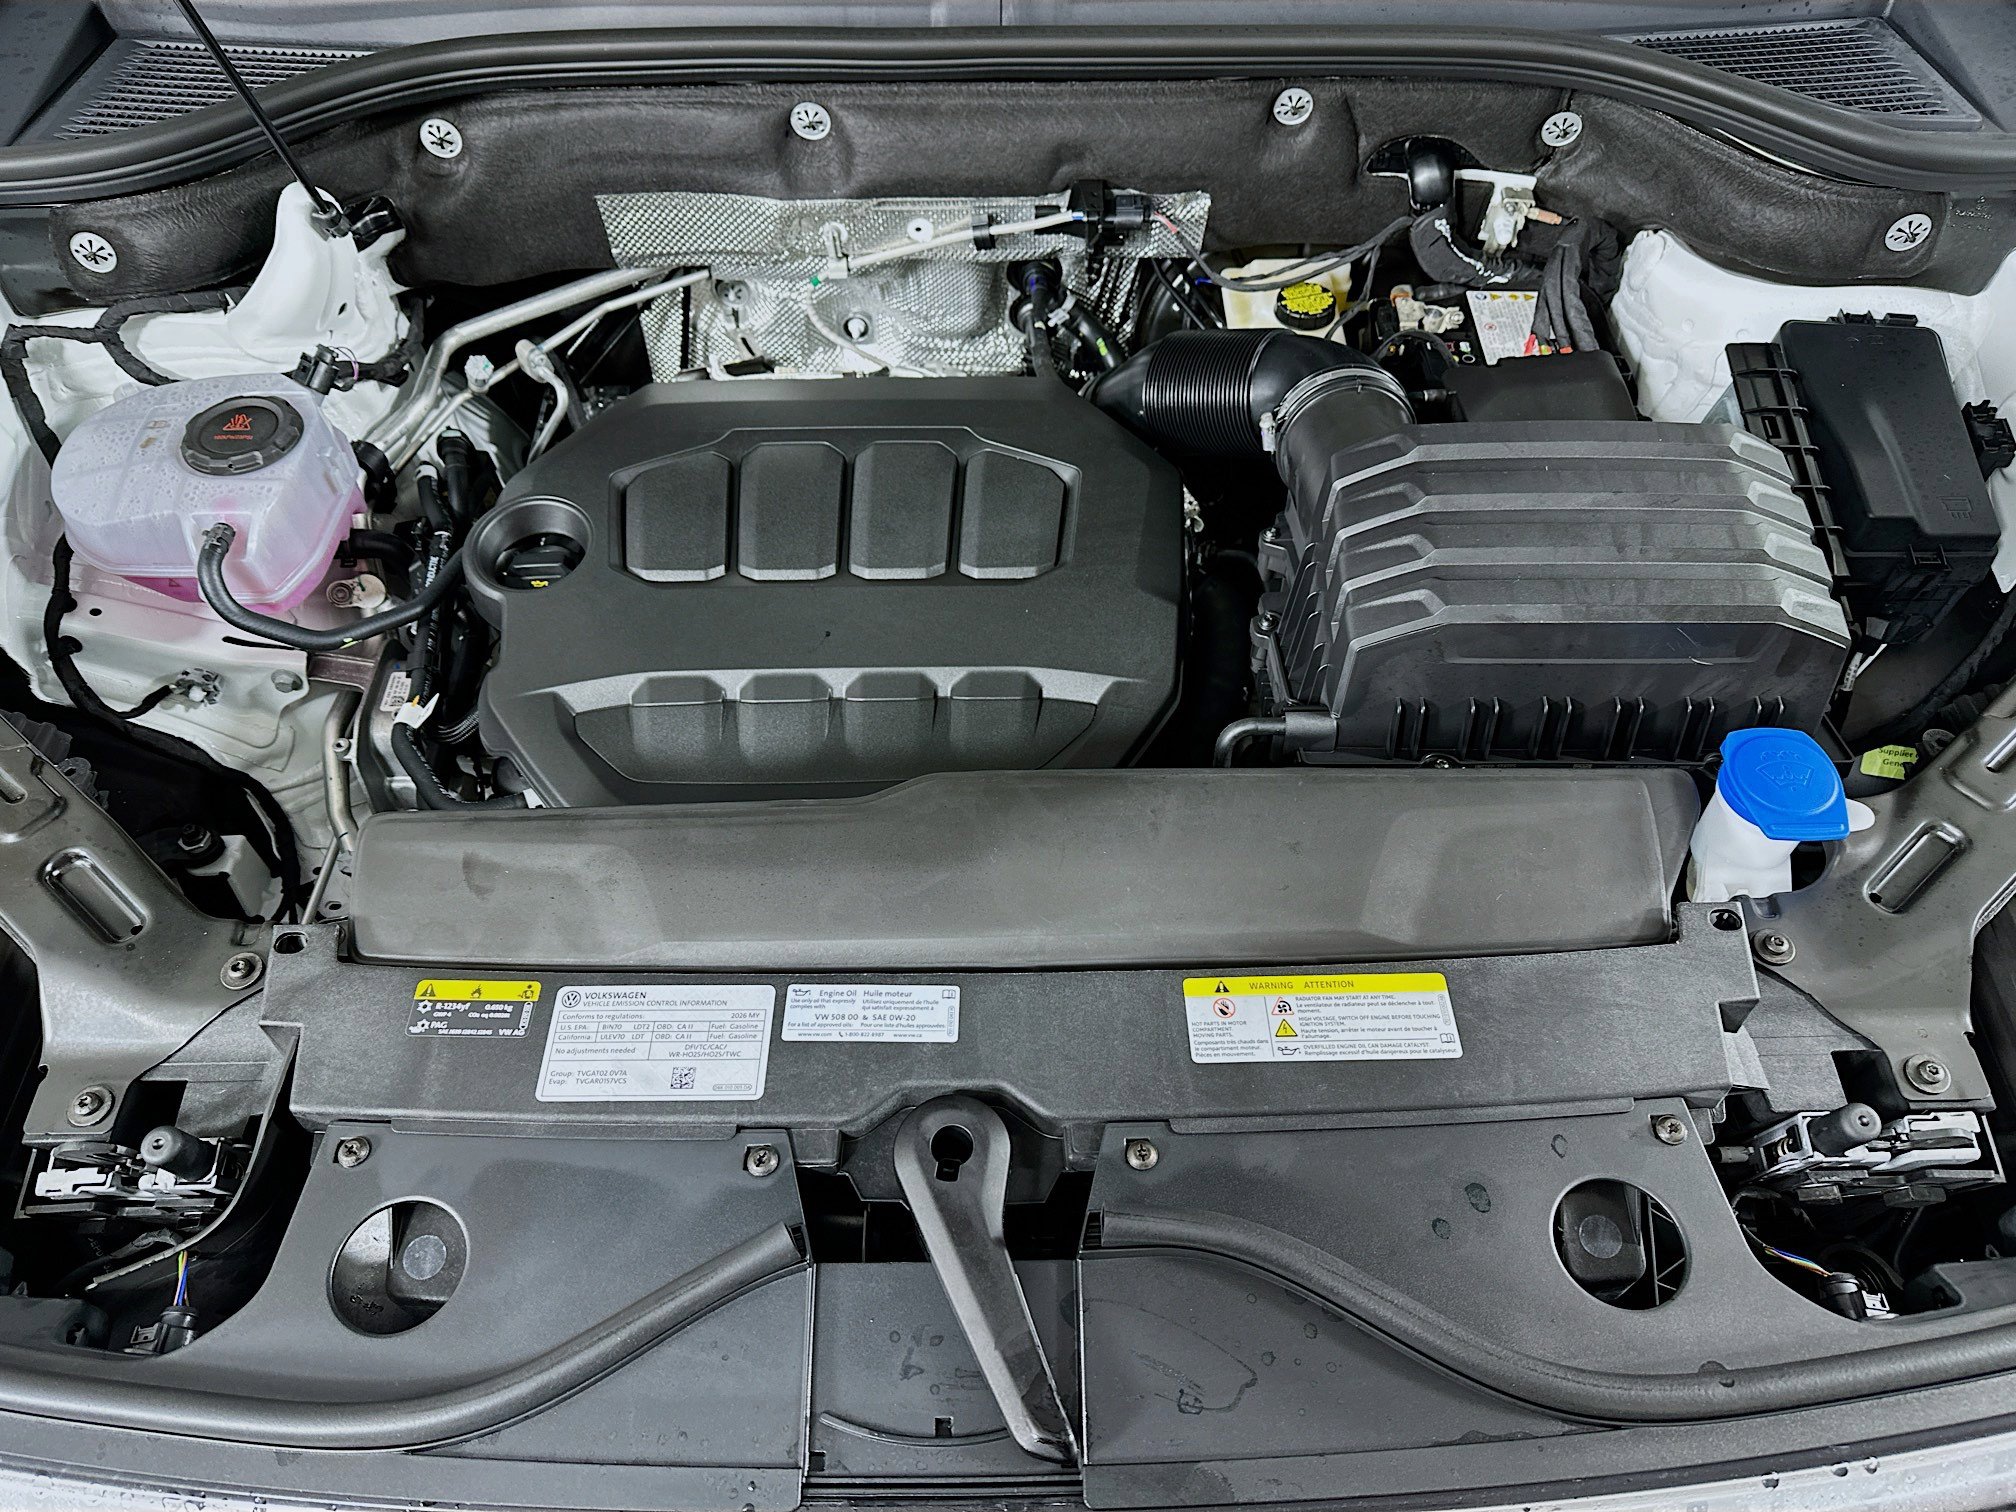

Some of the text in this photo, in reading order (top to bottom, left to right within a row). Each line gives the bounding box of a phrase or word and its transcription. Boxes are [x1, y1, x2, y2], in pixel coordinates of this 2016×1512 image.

[1879, 748, 1913, 757] Supplier
[435, 1002, 471, 1012] R-1234yf
[504, 1004, 513, 1012] kg
[605, 1012, 645, 1021] regulations:
[566, 1048, 609, 1056] adjustments
